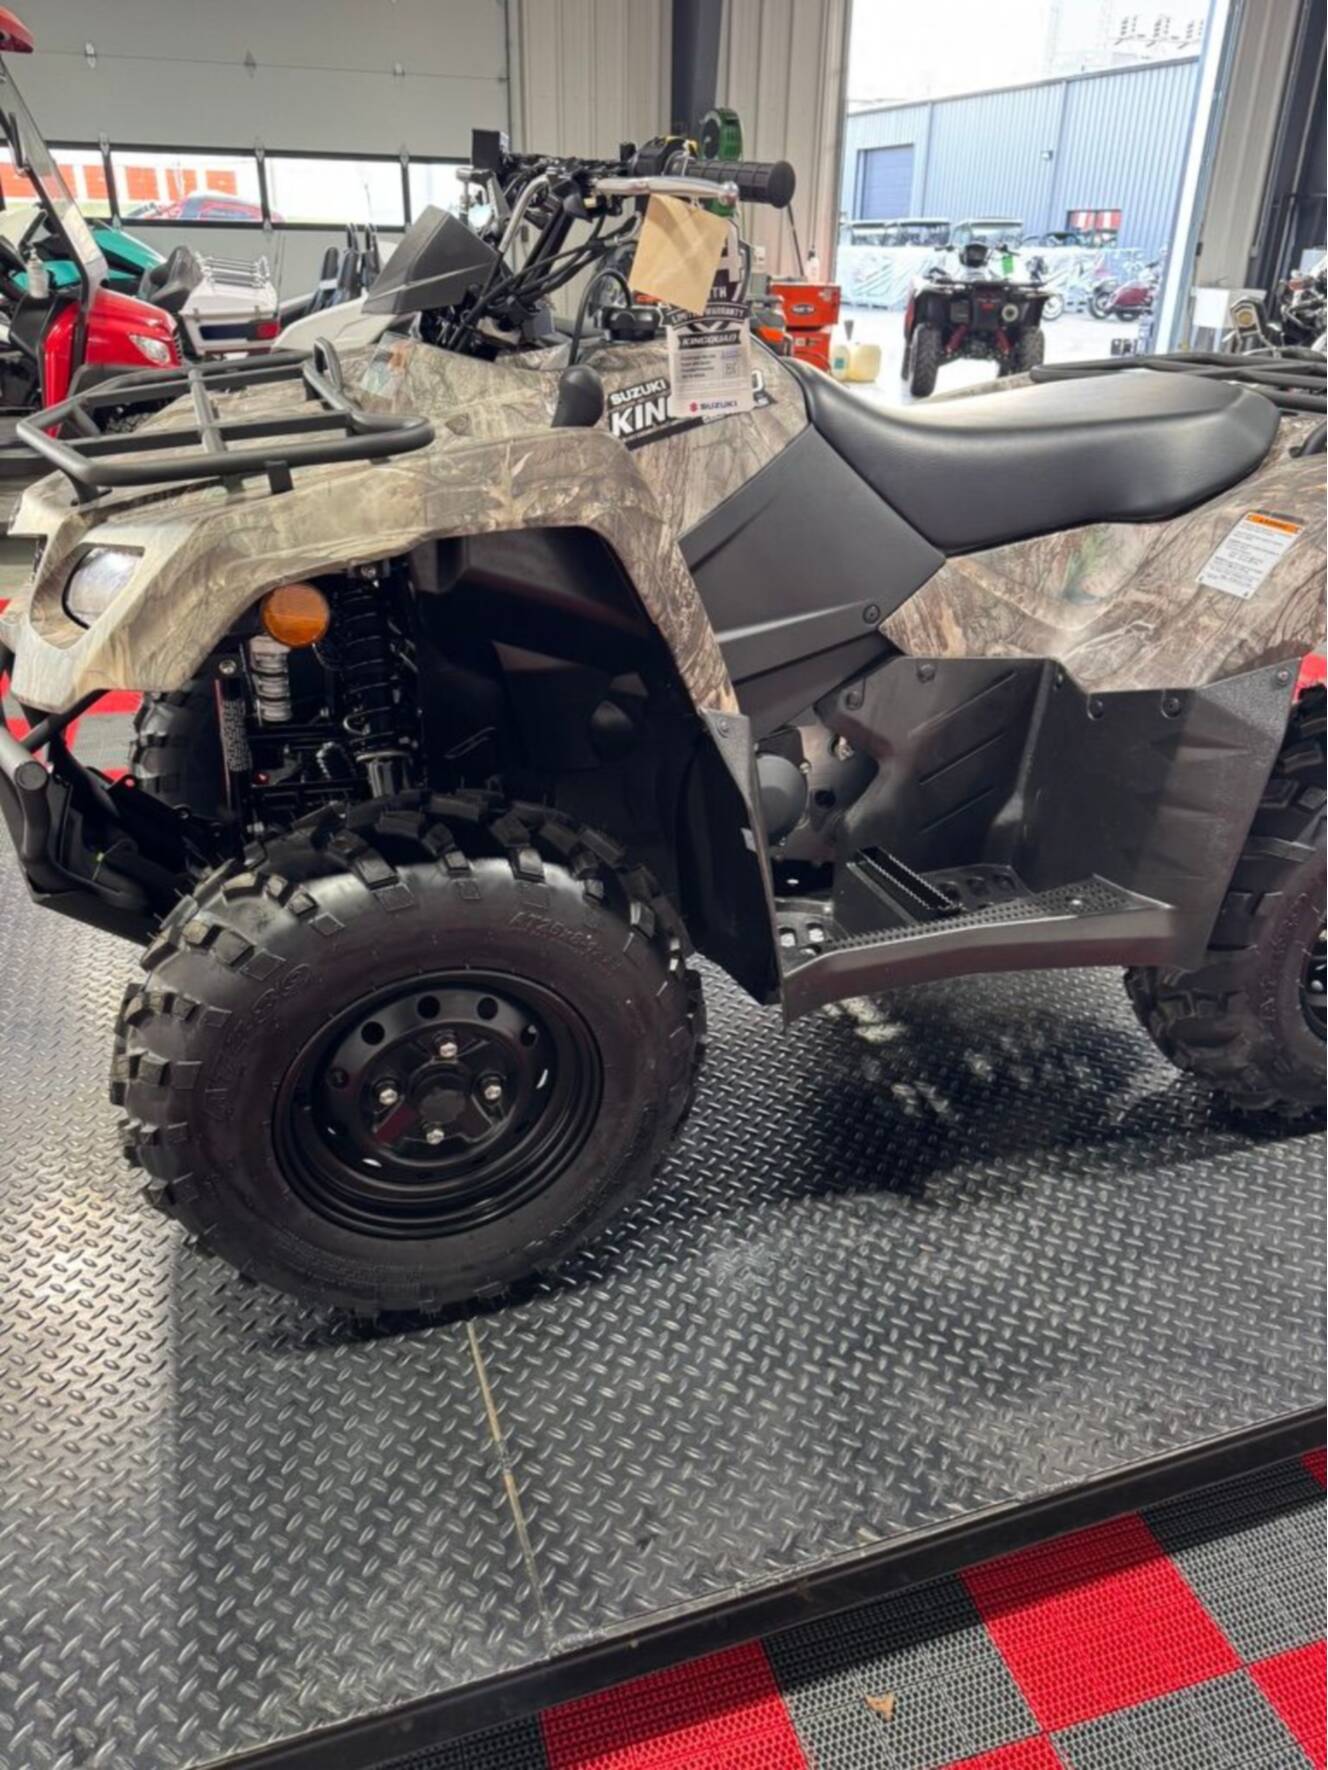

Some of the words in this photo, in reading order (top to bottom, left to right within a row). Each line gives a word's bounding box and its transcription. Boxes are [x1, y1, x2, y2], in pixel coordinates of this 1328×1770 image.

[681, 334, 737, 346] KINGQUAD
[610, 378, 667, 406] SUZUKI
[700, 400, 738, 411] SUZUKI
[611, 397, 668, 438] KIN
